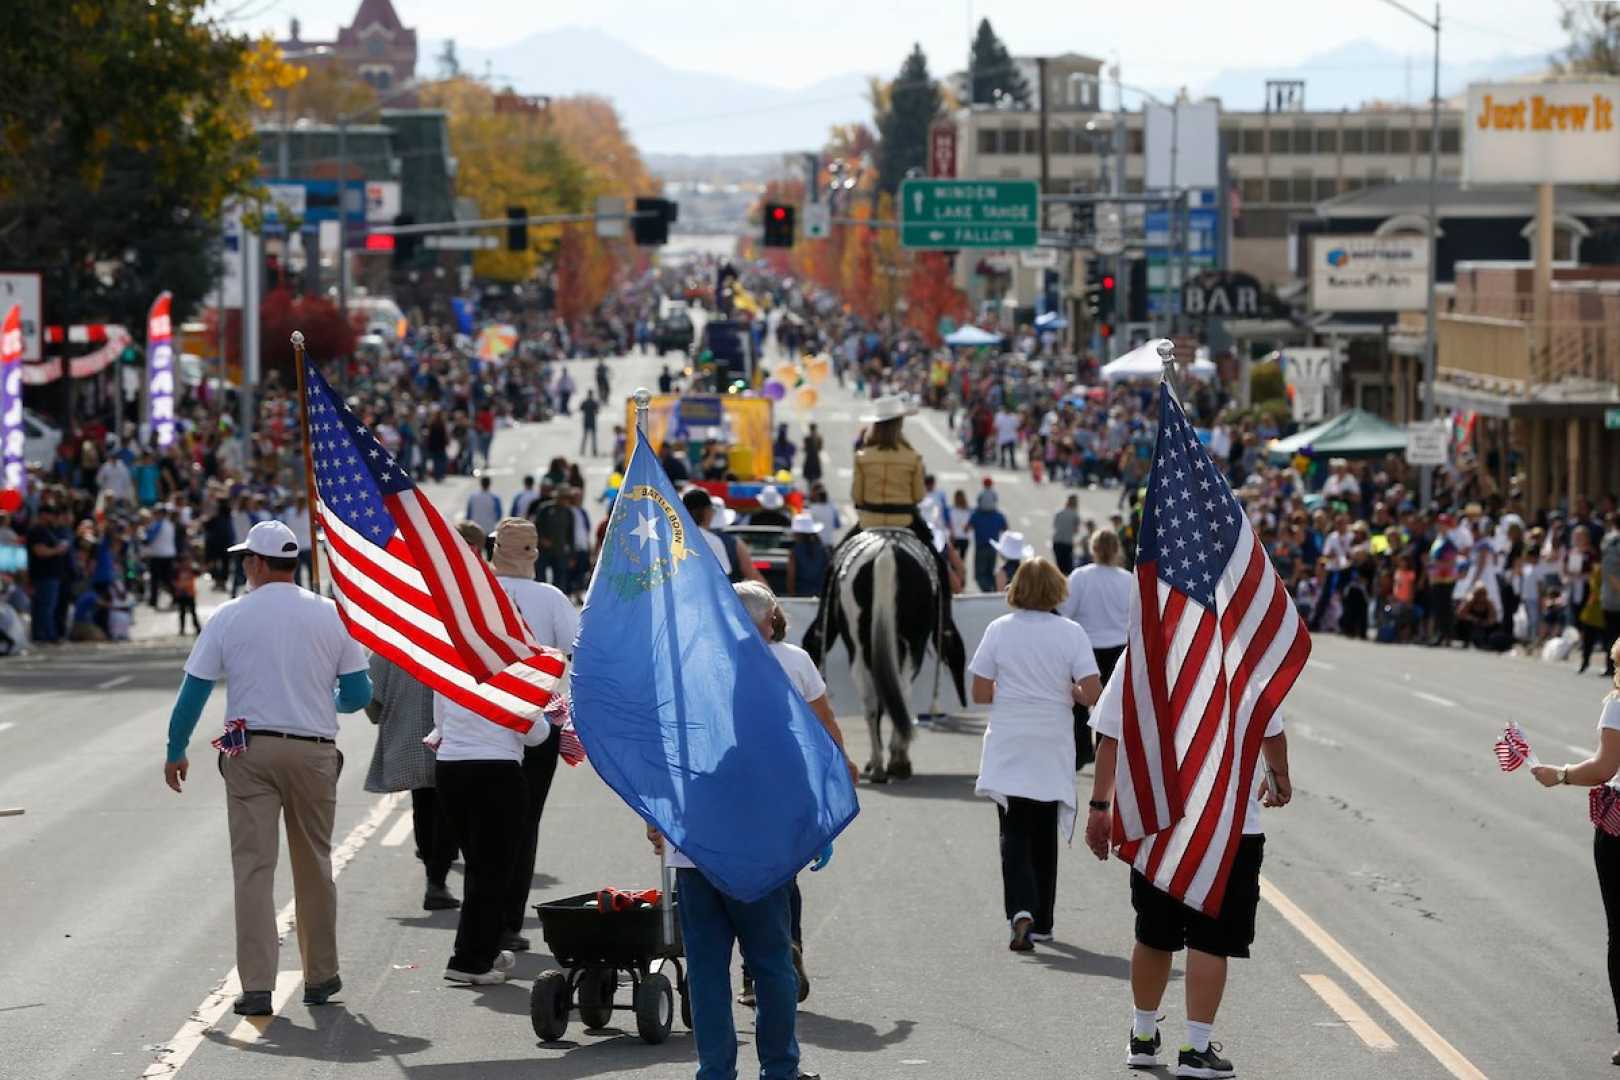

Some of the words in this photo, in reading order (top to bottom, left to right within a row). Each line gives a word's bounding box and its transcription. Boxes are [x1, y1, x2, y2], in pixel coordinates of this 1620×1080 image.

[1478, 94, 1525, 129] Just
[1531, 95, 1589, 129] Brew
[1594, 93, 1613, 129] It
[934, 187, 997, 198] MINDEN
[934, 206, 972, 218] LAKE
[982, 206, 1029, 218] TAHOE
[955, 229, 1013, 242] FALLON
[1185, 285, 1257, 313] BAR
[641, 488, 671, 514] BATTLE
[669, 514, 682, 543] BORN
